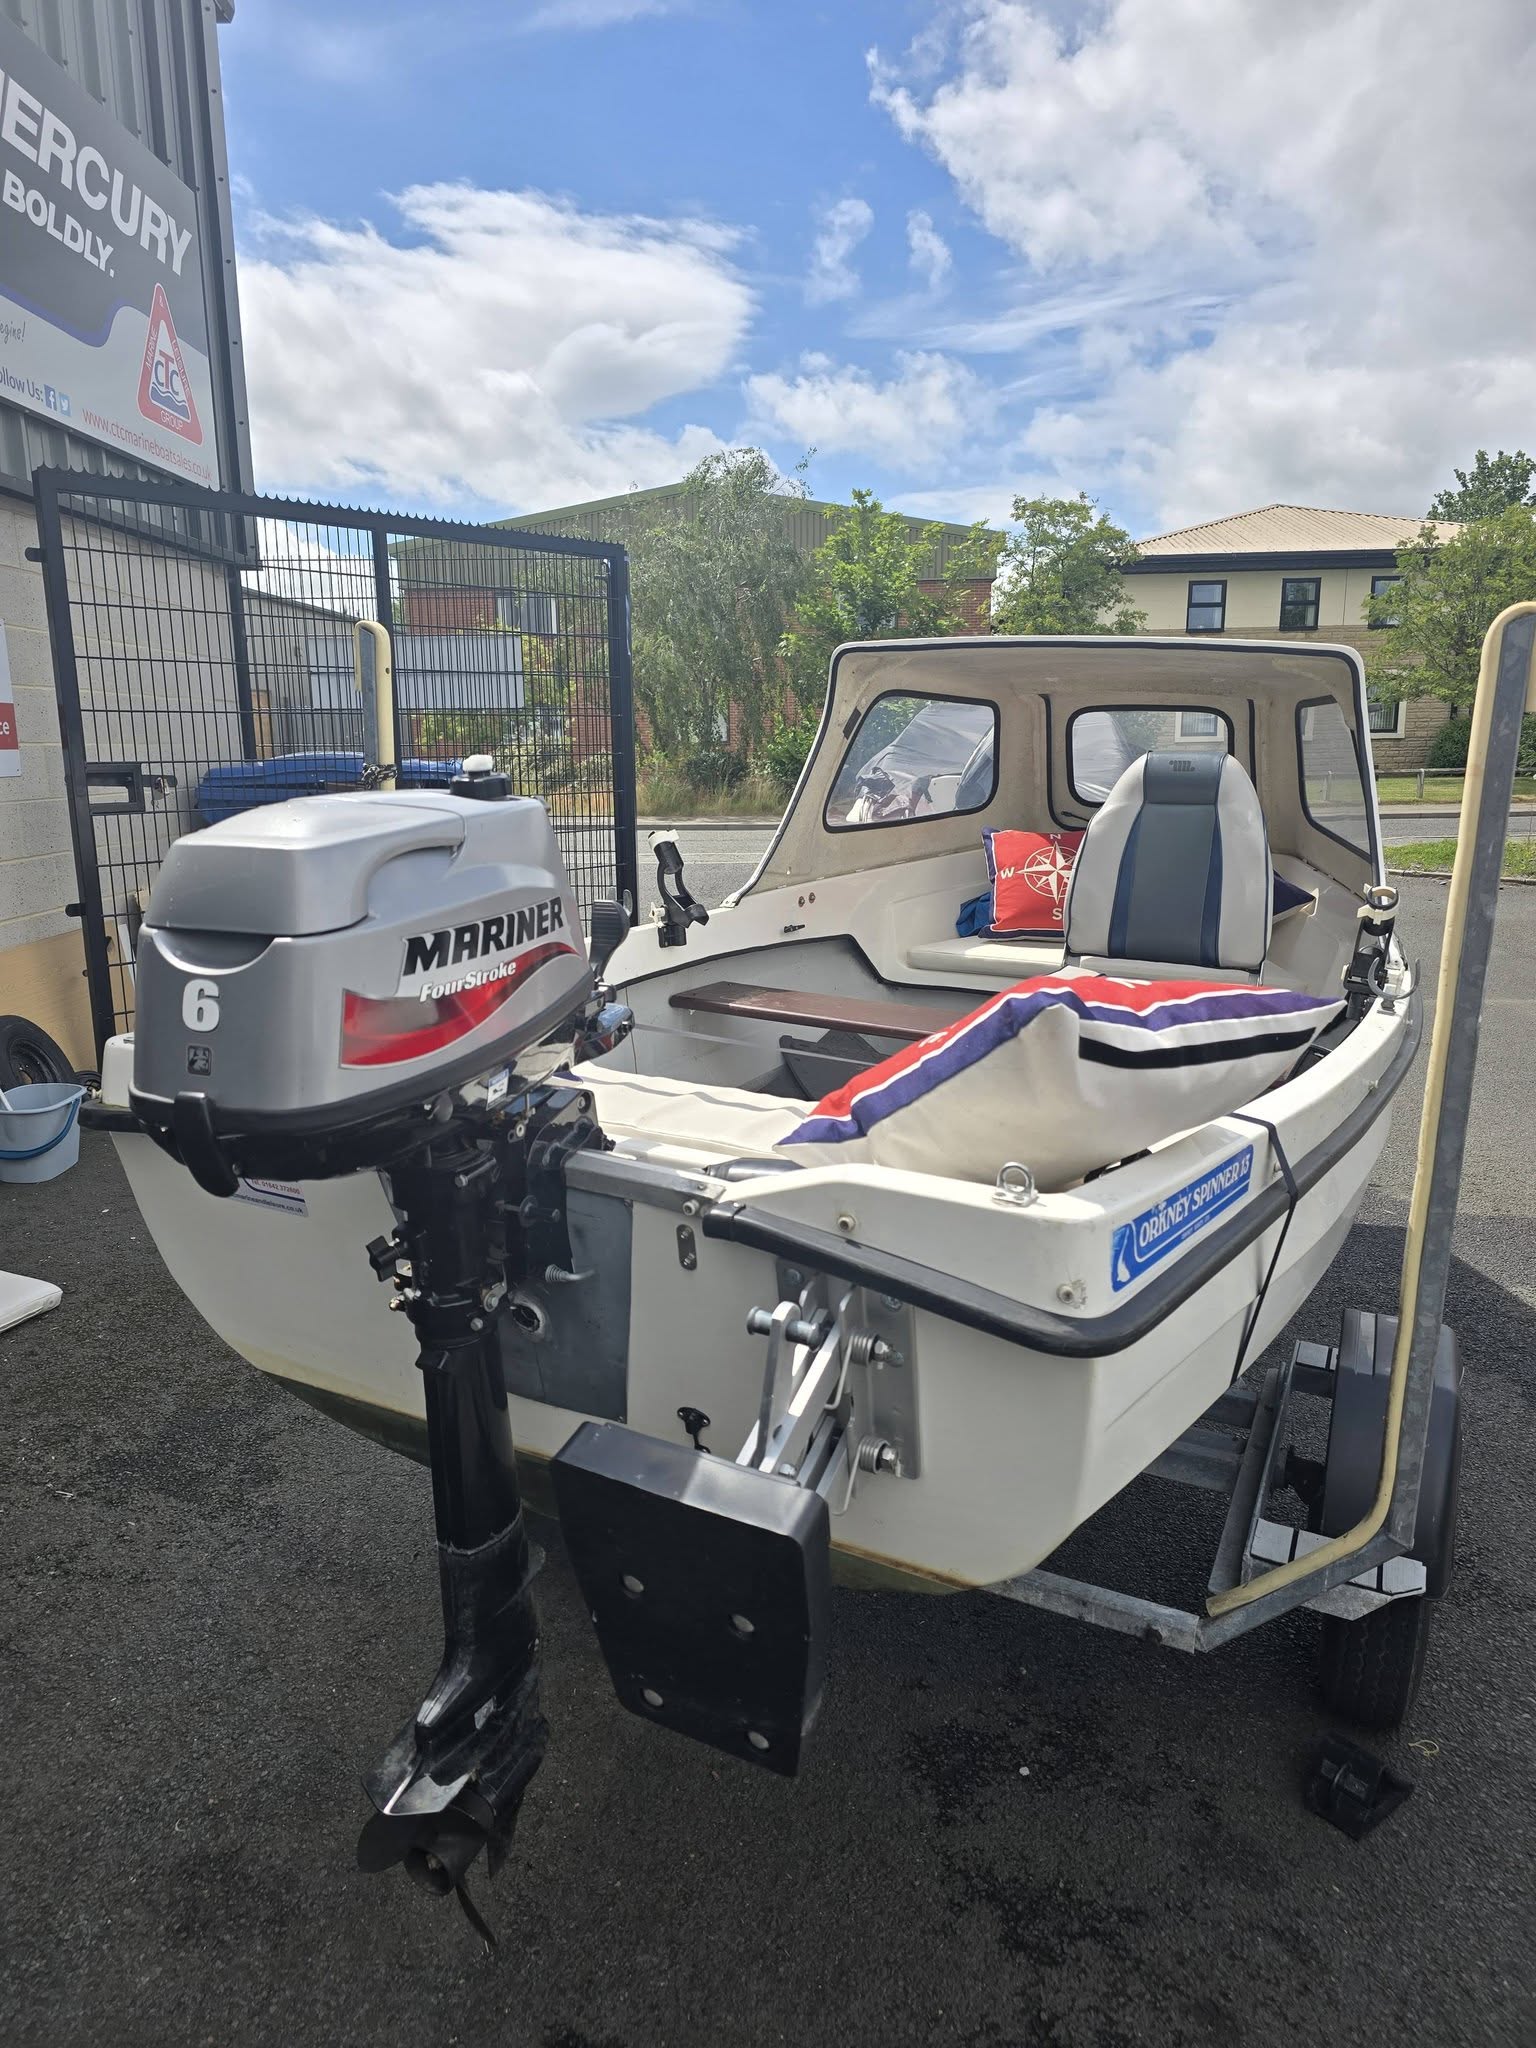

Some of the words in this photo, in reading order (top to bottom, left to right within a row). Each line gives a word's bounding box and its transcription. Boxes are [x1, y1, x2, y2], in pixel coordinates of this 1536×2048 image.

[0, 68, 193, 277] ERCURY
[3, 168, 114, 278] BOLDLY.
[144, 323, 159, 369] MARINE
[171, 338, 191, 393] LEISURE
[26, 379, 44, 402] Us:
[154, 349, 180, 396] CTC
[82, 407, 213, 482] www.ctcmarineboatsales.co.uk
[160, 409, 184, 432] GROUP
[1000, 867, 1015, 879] W
[402, 896, 565, 977] MARINER
[1052, 908, 1063, 920] S
[182, 978, 220, 1032] 6
[419, 961, 517, 1003] FourStroke
[1140, 1193, 1192, 1248] ORKNEY
[1191, 1162, 1240, 1211] SPINNER
